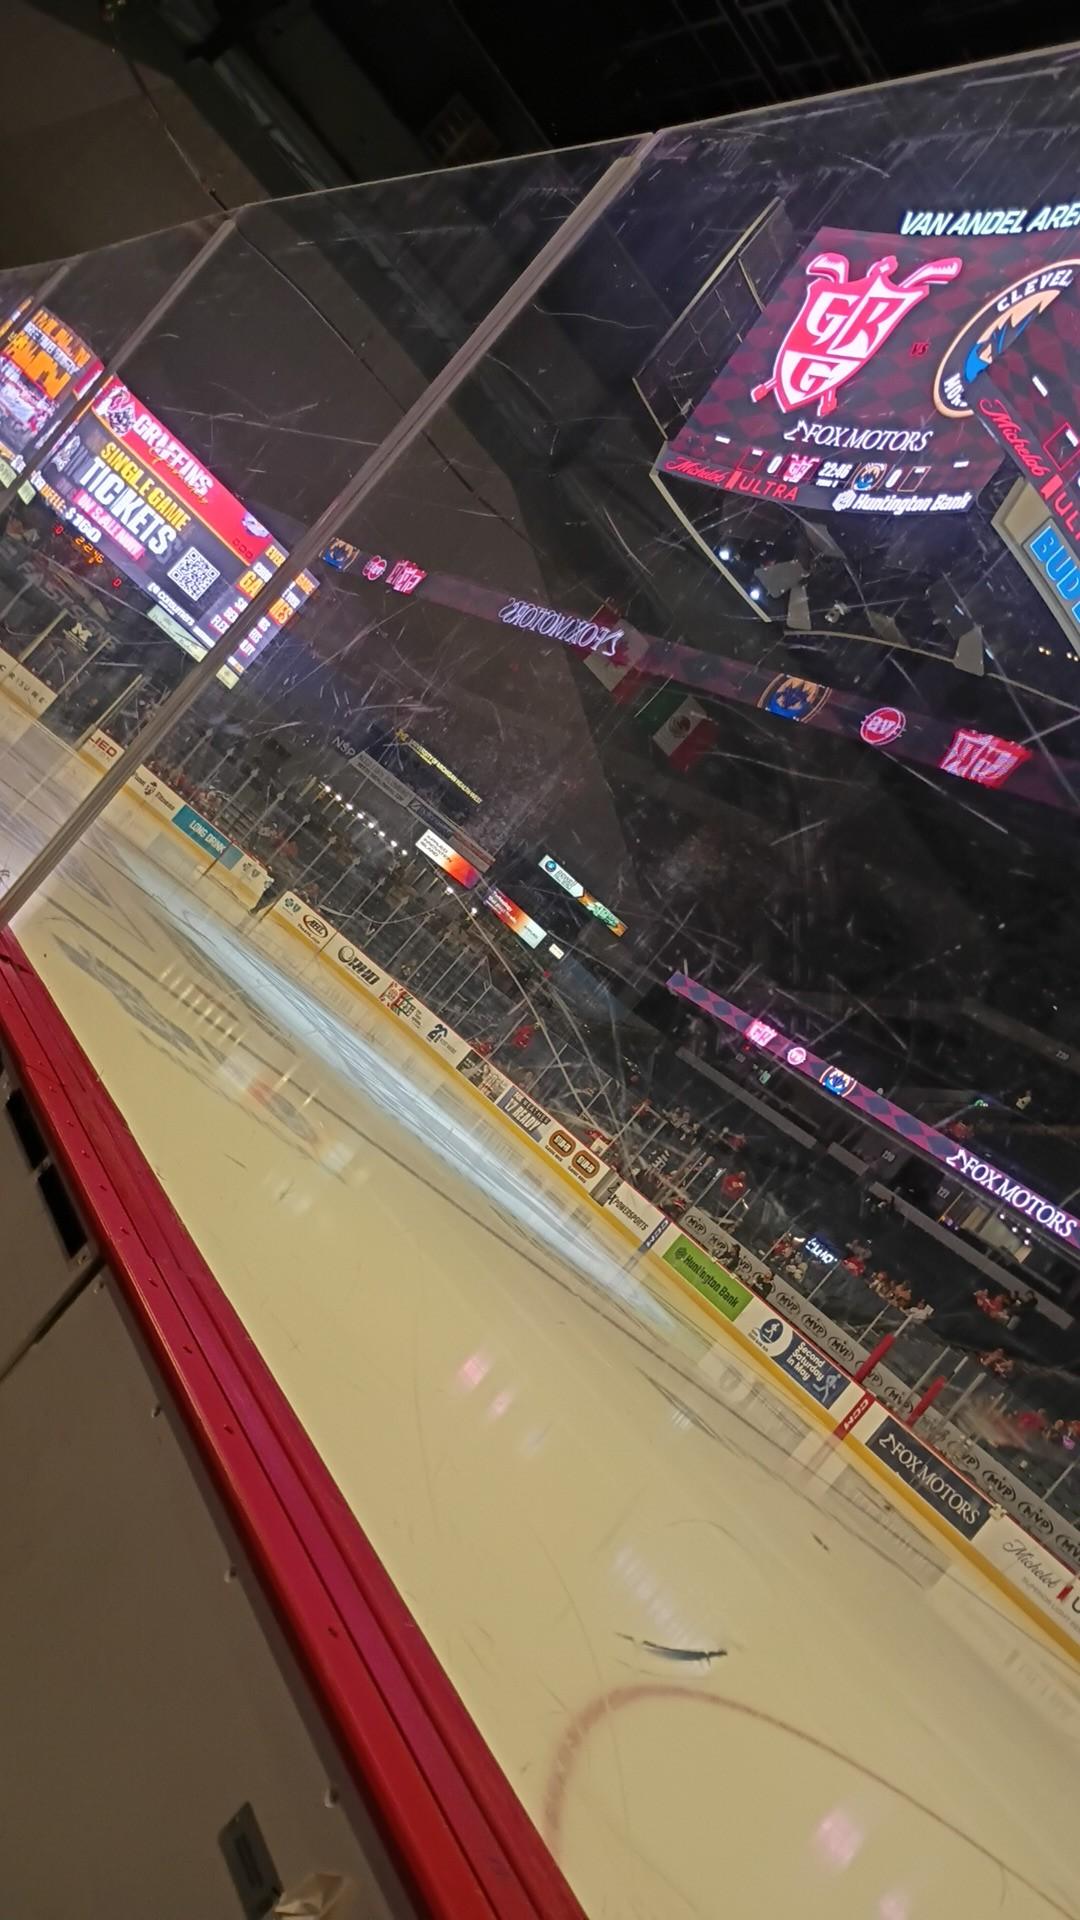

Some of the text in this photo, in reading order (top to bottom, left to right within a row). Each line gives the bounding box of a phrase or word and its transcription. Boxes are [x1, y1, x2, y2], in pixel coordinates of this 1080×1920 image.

[900, 211, 954, 236] VAN
[947, 209, 1028, 236] ANDEL
[997, 269, 1074, 312] CLEVEL
[801, 424, 933, 452] FOX MOTORS
[133, 414, 214, 497] GRIFFINS
[766, 455, 784, 475] 0
[979, 398, 1080, 541] Michelob UL
[100, 442, 192, 532] SINGLE GAME
[665, 456, 800, 501] Michelob ULTRA
[885, 468, 903, 488] 0
[80, 456, 177, 554] TICKETS
[853, 491, 973, 516] Huntington Bank
[189, 819, 227, 855] LONG DRINK
[513, 1105, 541, 1131] READY
[960, 1156, 1078, 1237] FOX MOTORS
[612, 1199, 649, 1232] POWERSPORTS
[688, 1216, 705, 1232] MVP
[683, 1254, 740, 1308] Huntington Bank
[780, 1295, 798, 1312] MVP
[805, 1317, 825, 1335] MVP
[791, 1348, 825, 1382] Saturday
[797, 1341, 825, 1368] Second
[793, 1363, 811, 1382] May
[843, 1398, 869, 1431] CCM
[889, 1442, 981, 1525] FOX MOTORS
[987, 1475, 1013, 1498] MVP
[1023, 1505, 1050, 1531] MVP
[1061, 1538, 1080, 1562] MV
